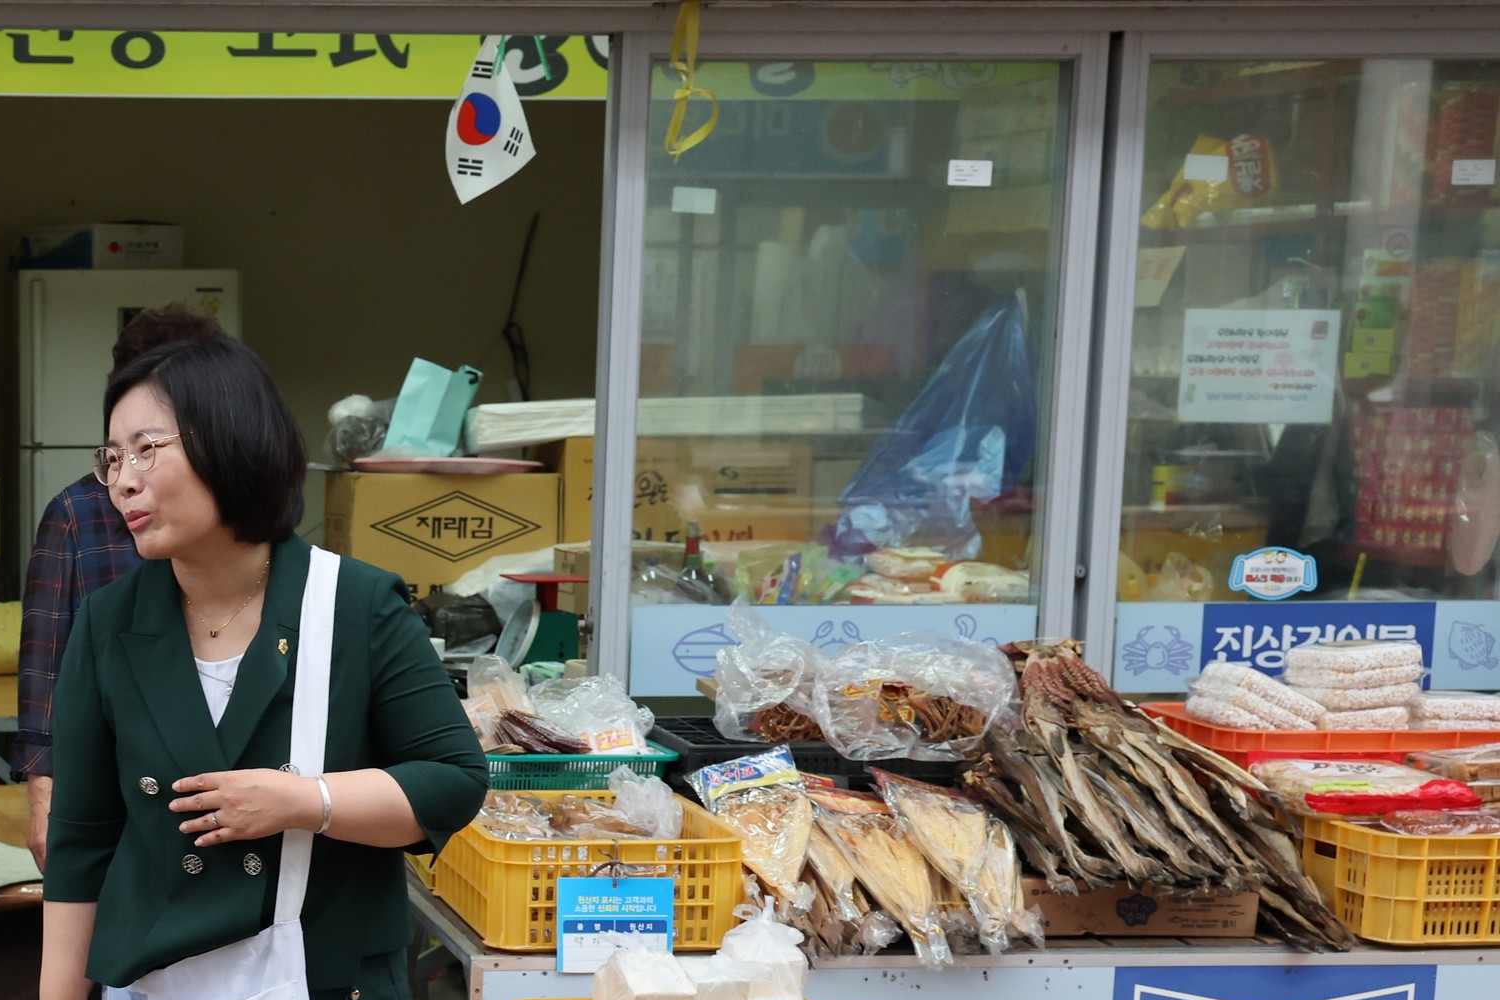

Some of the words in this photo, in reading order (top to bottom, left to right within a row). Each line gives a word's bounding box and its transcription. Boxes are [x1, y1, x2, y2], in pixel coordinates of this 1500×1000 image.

[416, 515, 495, 540] 재래김
[578, 896, 599, 904] 원산지
[601, 896, 622, 904] 표시는
[625, 896, 654, 904] 고객과의
[574, 905, 595, 913] 소중한
[598, 905, 619, 913] 신뢰의
[622, 905, 657, 913] 시작입니다
